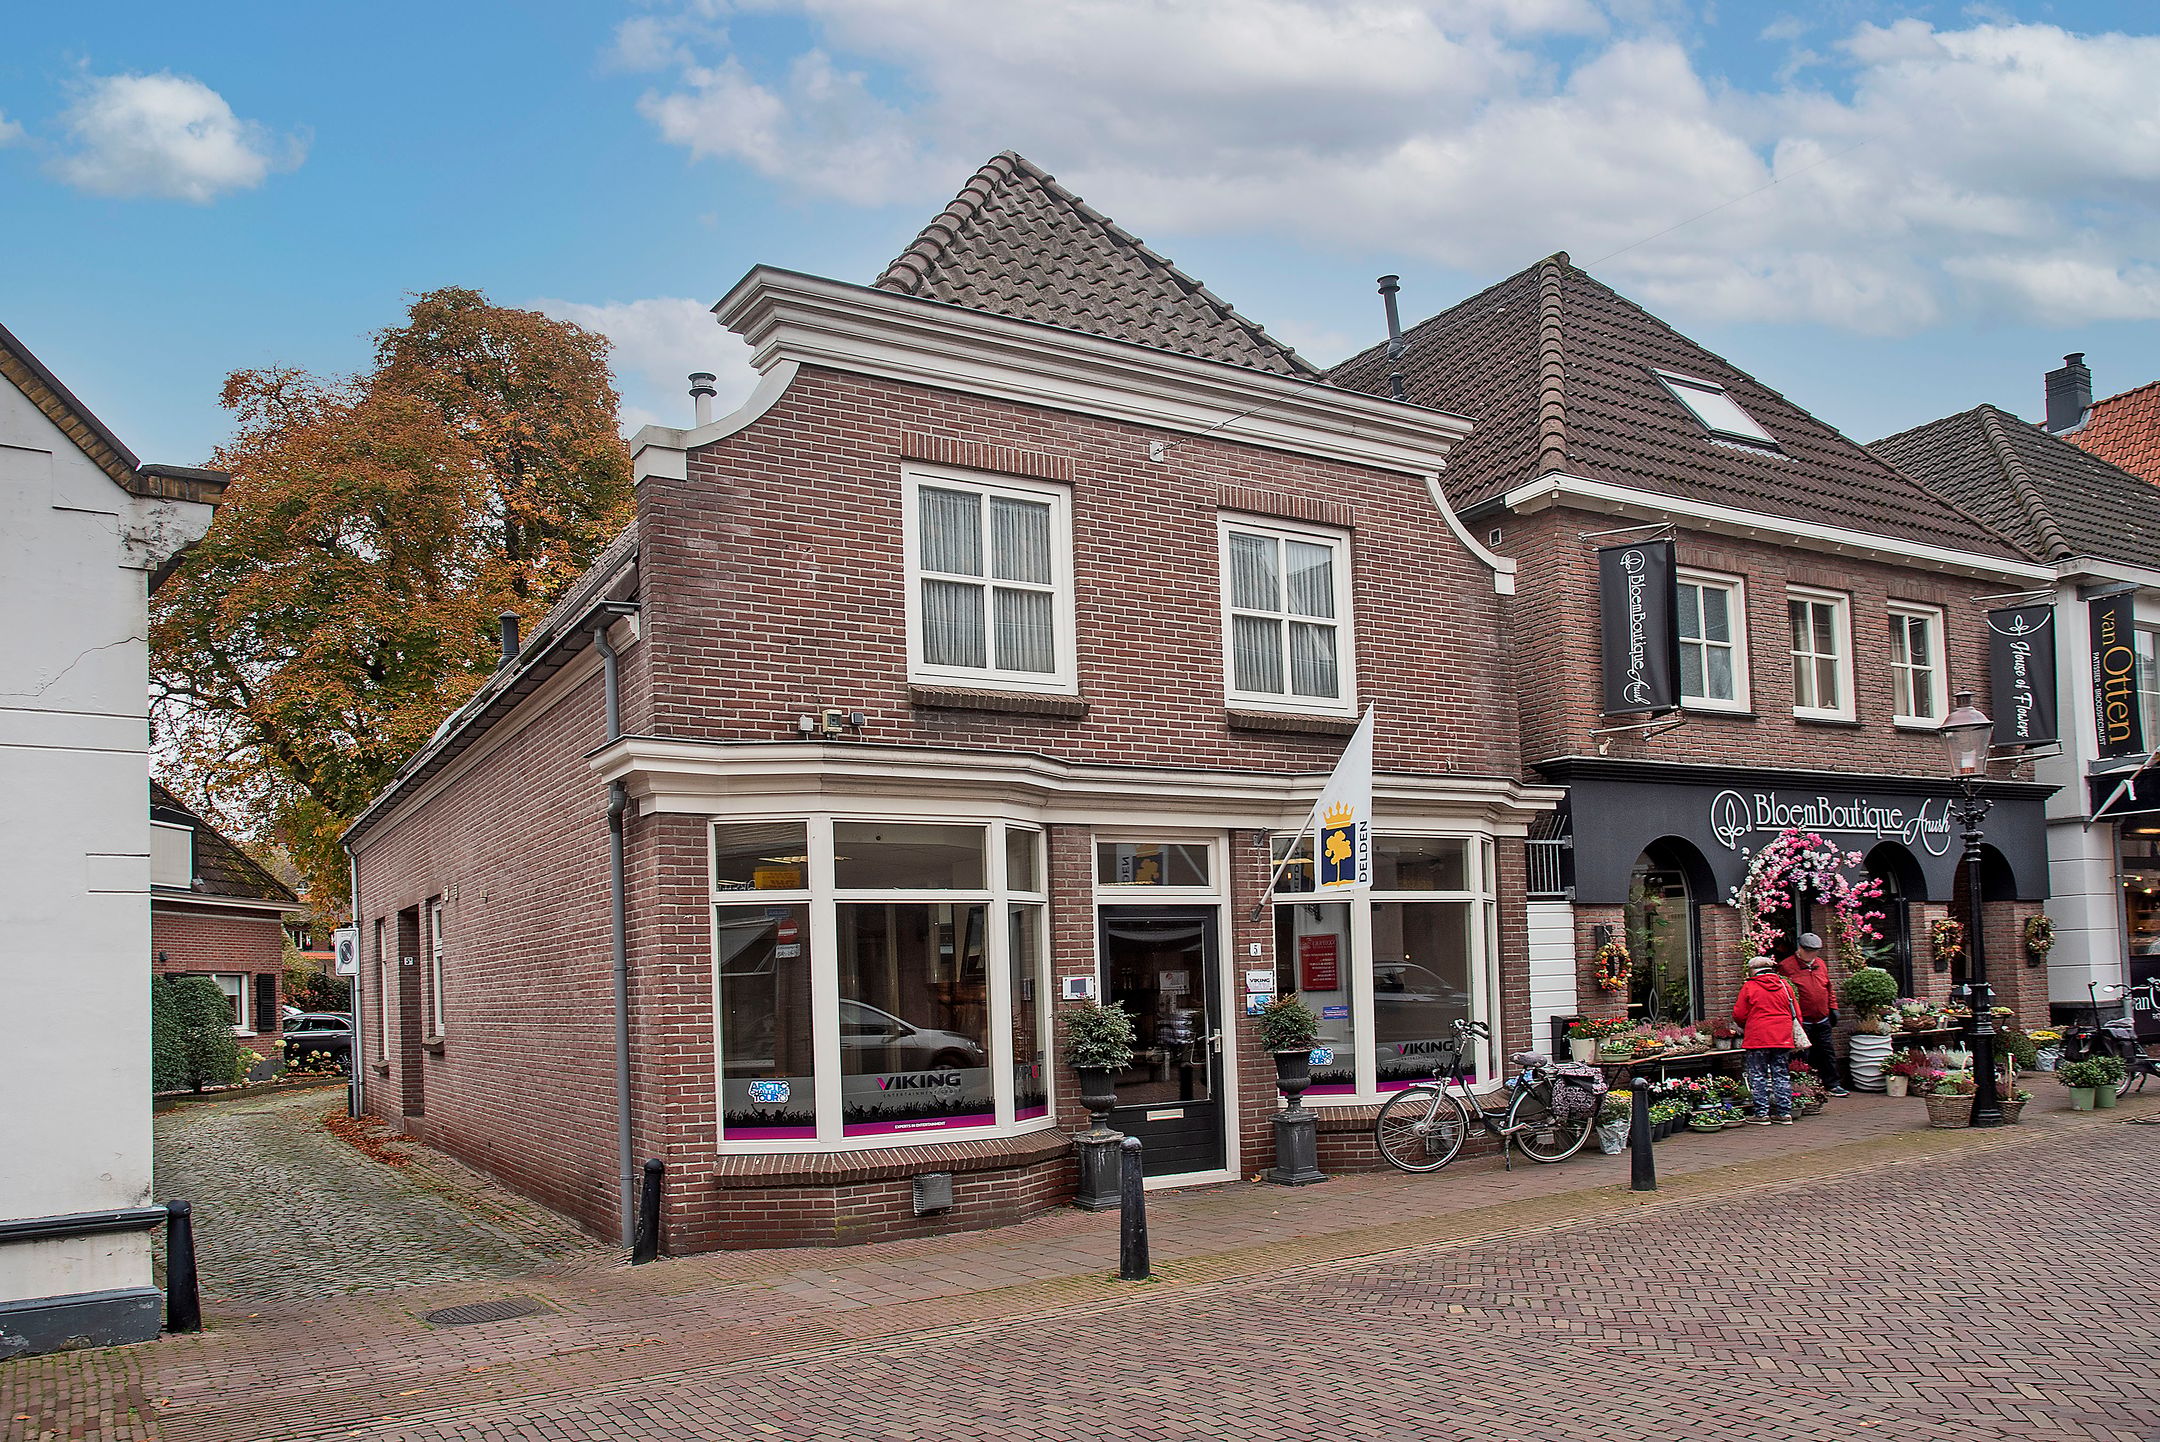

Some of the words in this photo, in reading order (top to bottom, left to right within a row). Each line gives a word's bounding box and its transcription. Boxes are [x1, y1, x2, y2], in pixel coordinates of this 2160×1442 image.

[1628, 574, 1647, 670] BloemBoutique
[2101, 609, 2116, 646] van
[2009, 641, 2032, 677] House
[1623, 669, 1651, 705] Anush
[2014, 679, 2031, 689] of
[2103, 646, 2135, 745] Otten
[2012, 692, 2033, 738] Flowers
[1753, 792, 1904, 839] BloemBoutique
[1902, 798, 1952, 856] Anush
[1358, 820, 1368, 883] DELDEN
[1253, 944, 1258, 955] 5
[2133, 996, 2151, 1011] an
[1397, 1040, 1455, 1056] VIKING
[751, 1082, 789, 1090] ARCTIC
[754, 1094, 779, 1102] TOUR
[876, 1072, 961, 1091] VIKING
